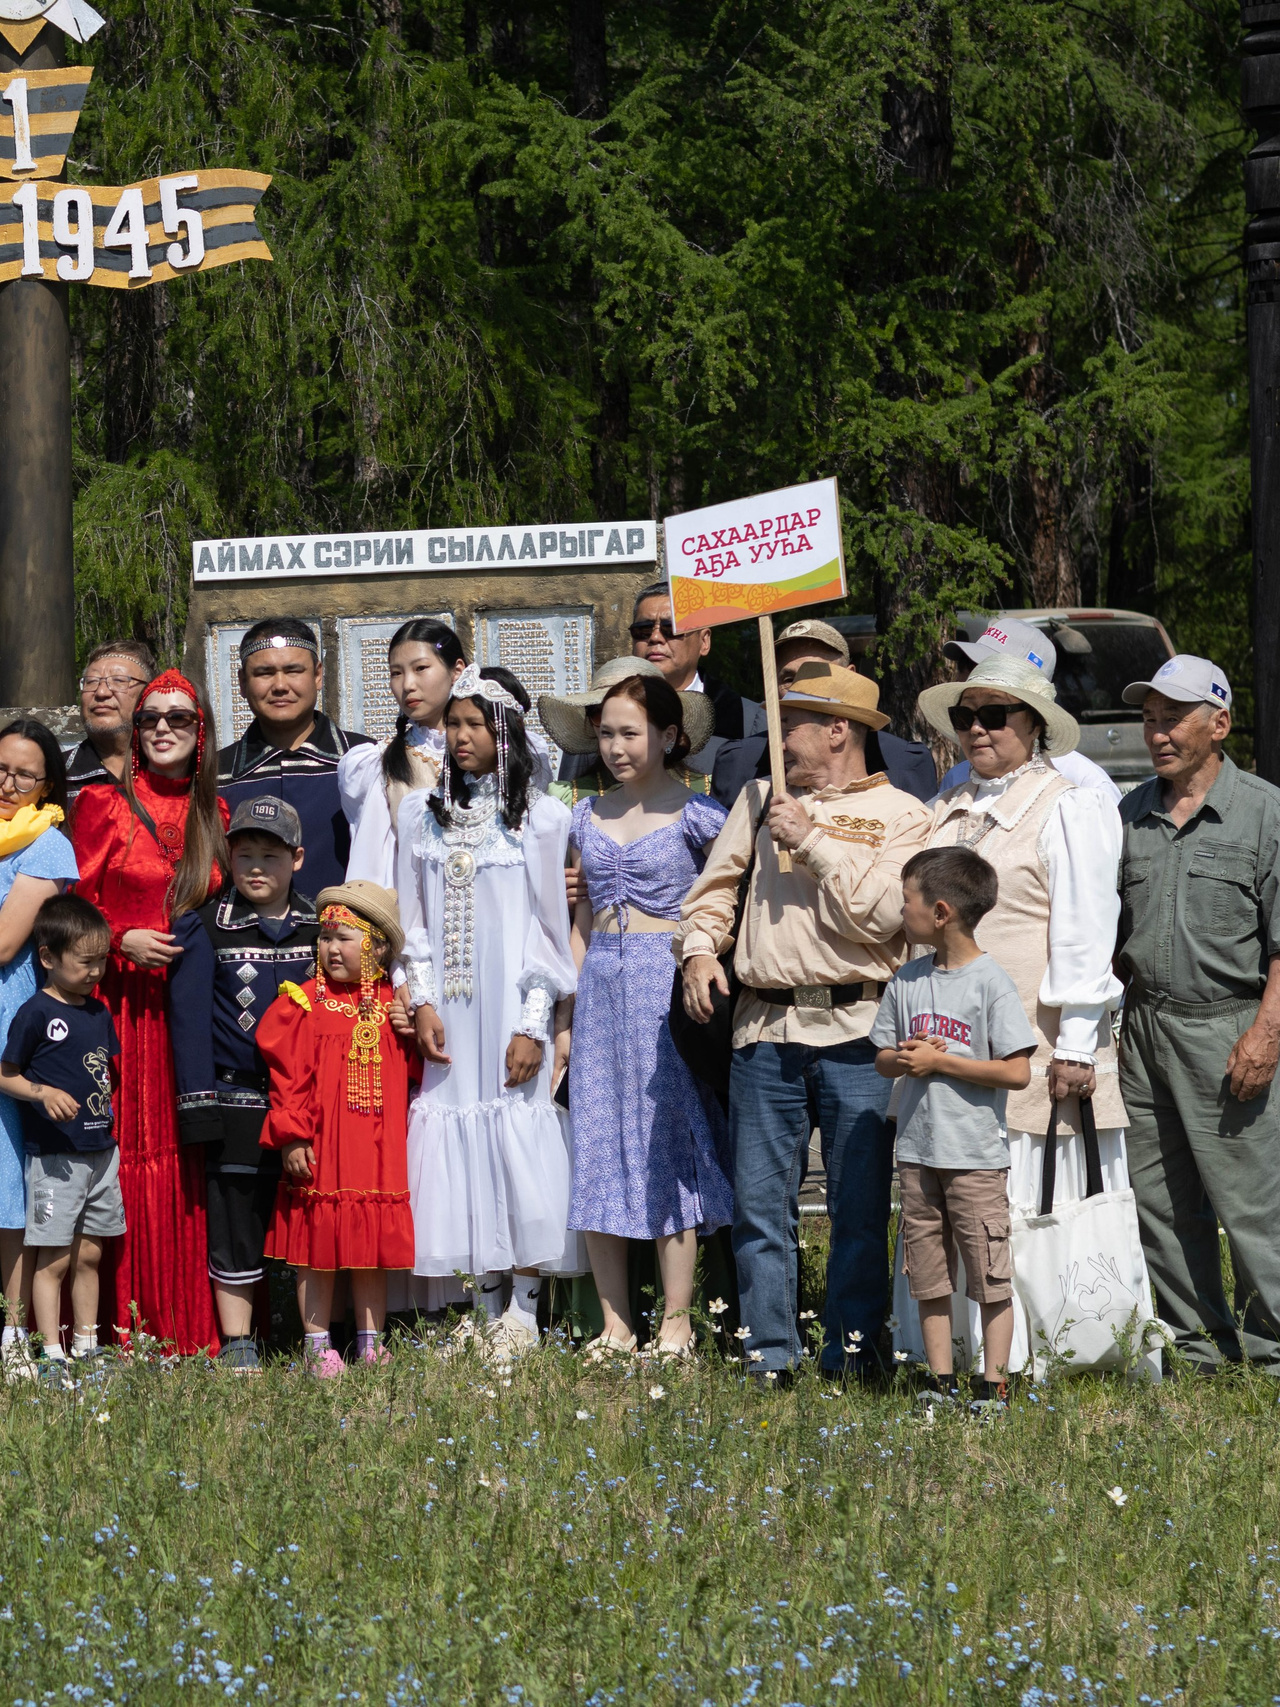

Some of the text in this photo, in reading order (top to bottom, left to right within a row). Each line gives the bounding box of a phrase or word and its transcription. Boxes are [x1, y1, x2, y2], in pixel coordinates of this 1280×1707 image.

[12, 175, 206, 281] 1945
[197, 527, 645, 574] АЙМАХ СЭРИИ СЫЛЛАРЫГАР
[681, 508, 822, 556] САХААРДАР
[693, 550, 741, 578] АҔА
[255, 805, 275, 816] 1816
[907, 1013, 971, 1046] OULTREE
